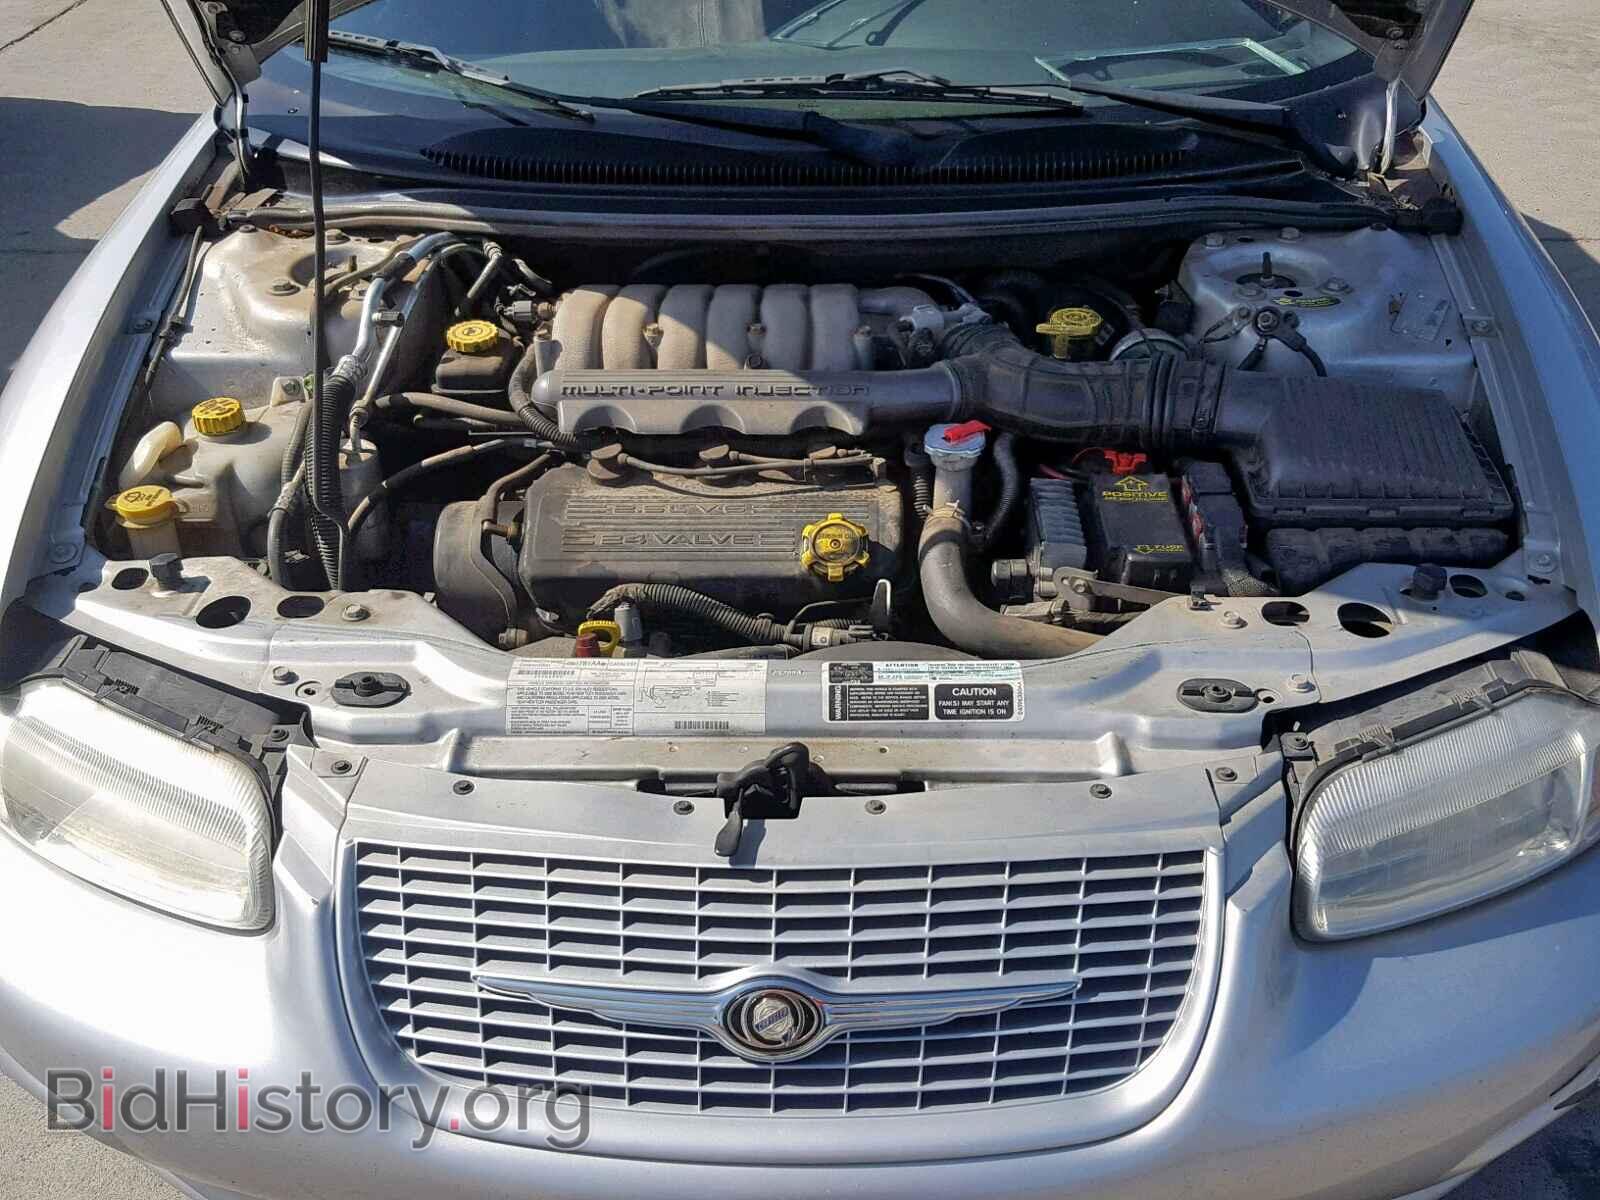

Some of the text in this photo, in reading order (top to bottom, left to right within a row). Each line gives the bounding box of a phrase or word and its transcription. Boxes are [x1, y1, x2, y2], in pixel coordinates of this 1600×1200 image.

[561, 384, 870, 397] MULTI-POINT INJECTION
[654, 534, 753, 545] VALVE
[951, 687, 997, 696] CAUTION
[834, 685, 842, 720] WARNING
